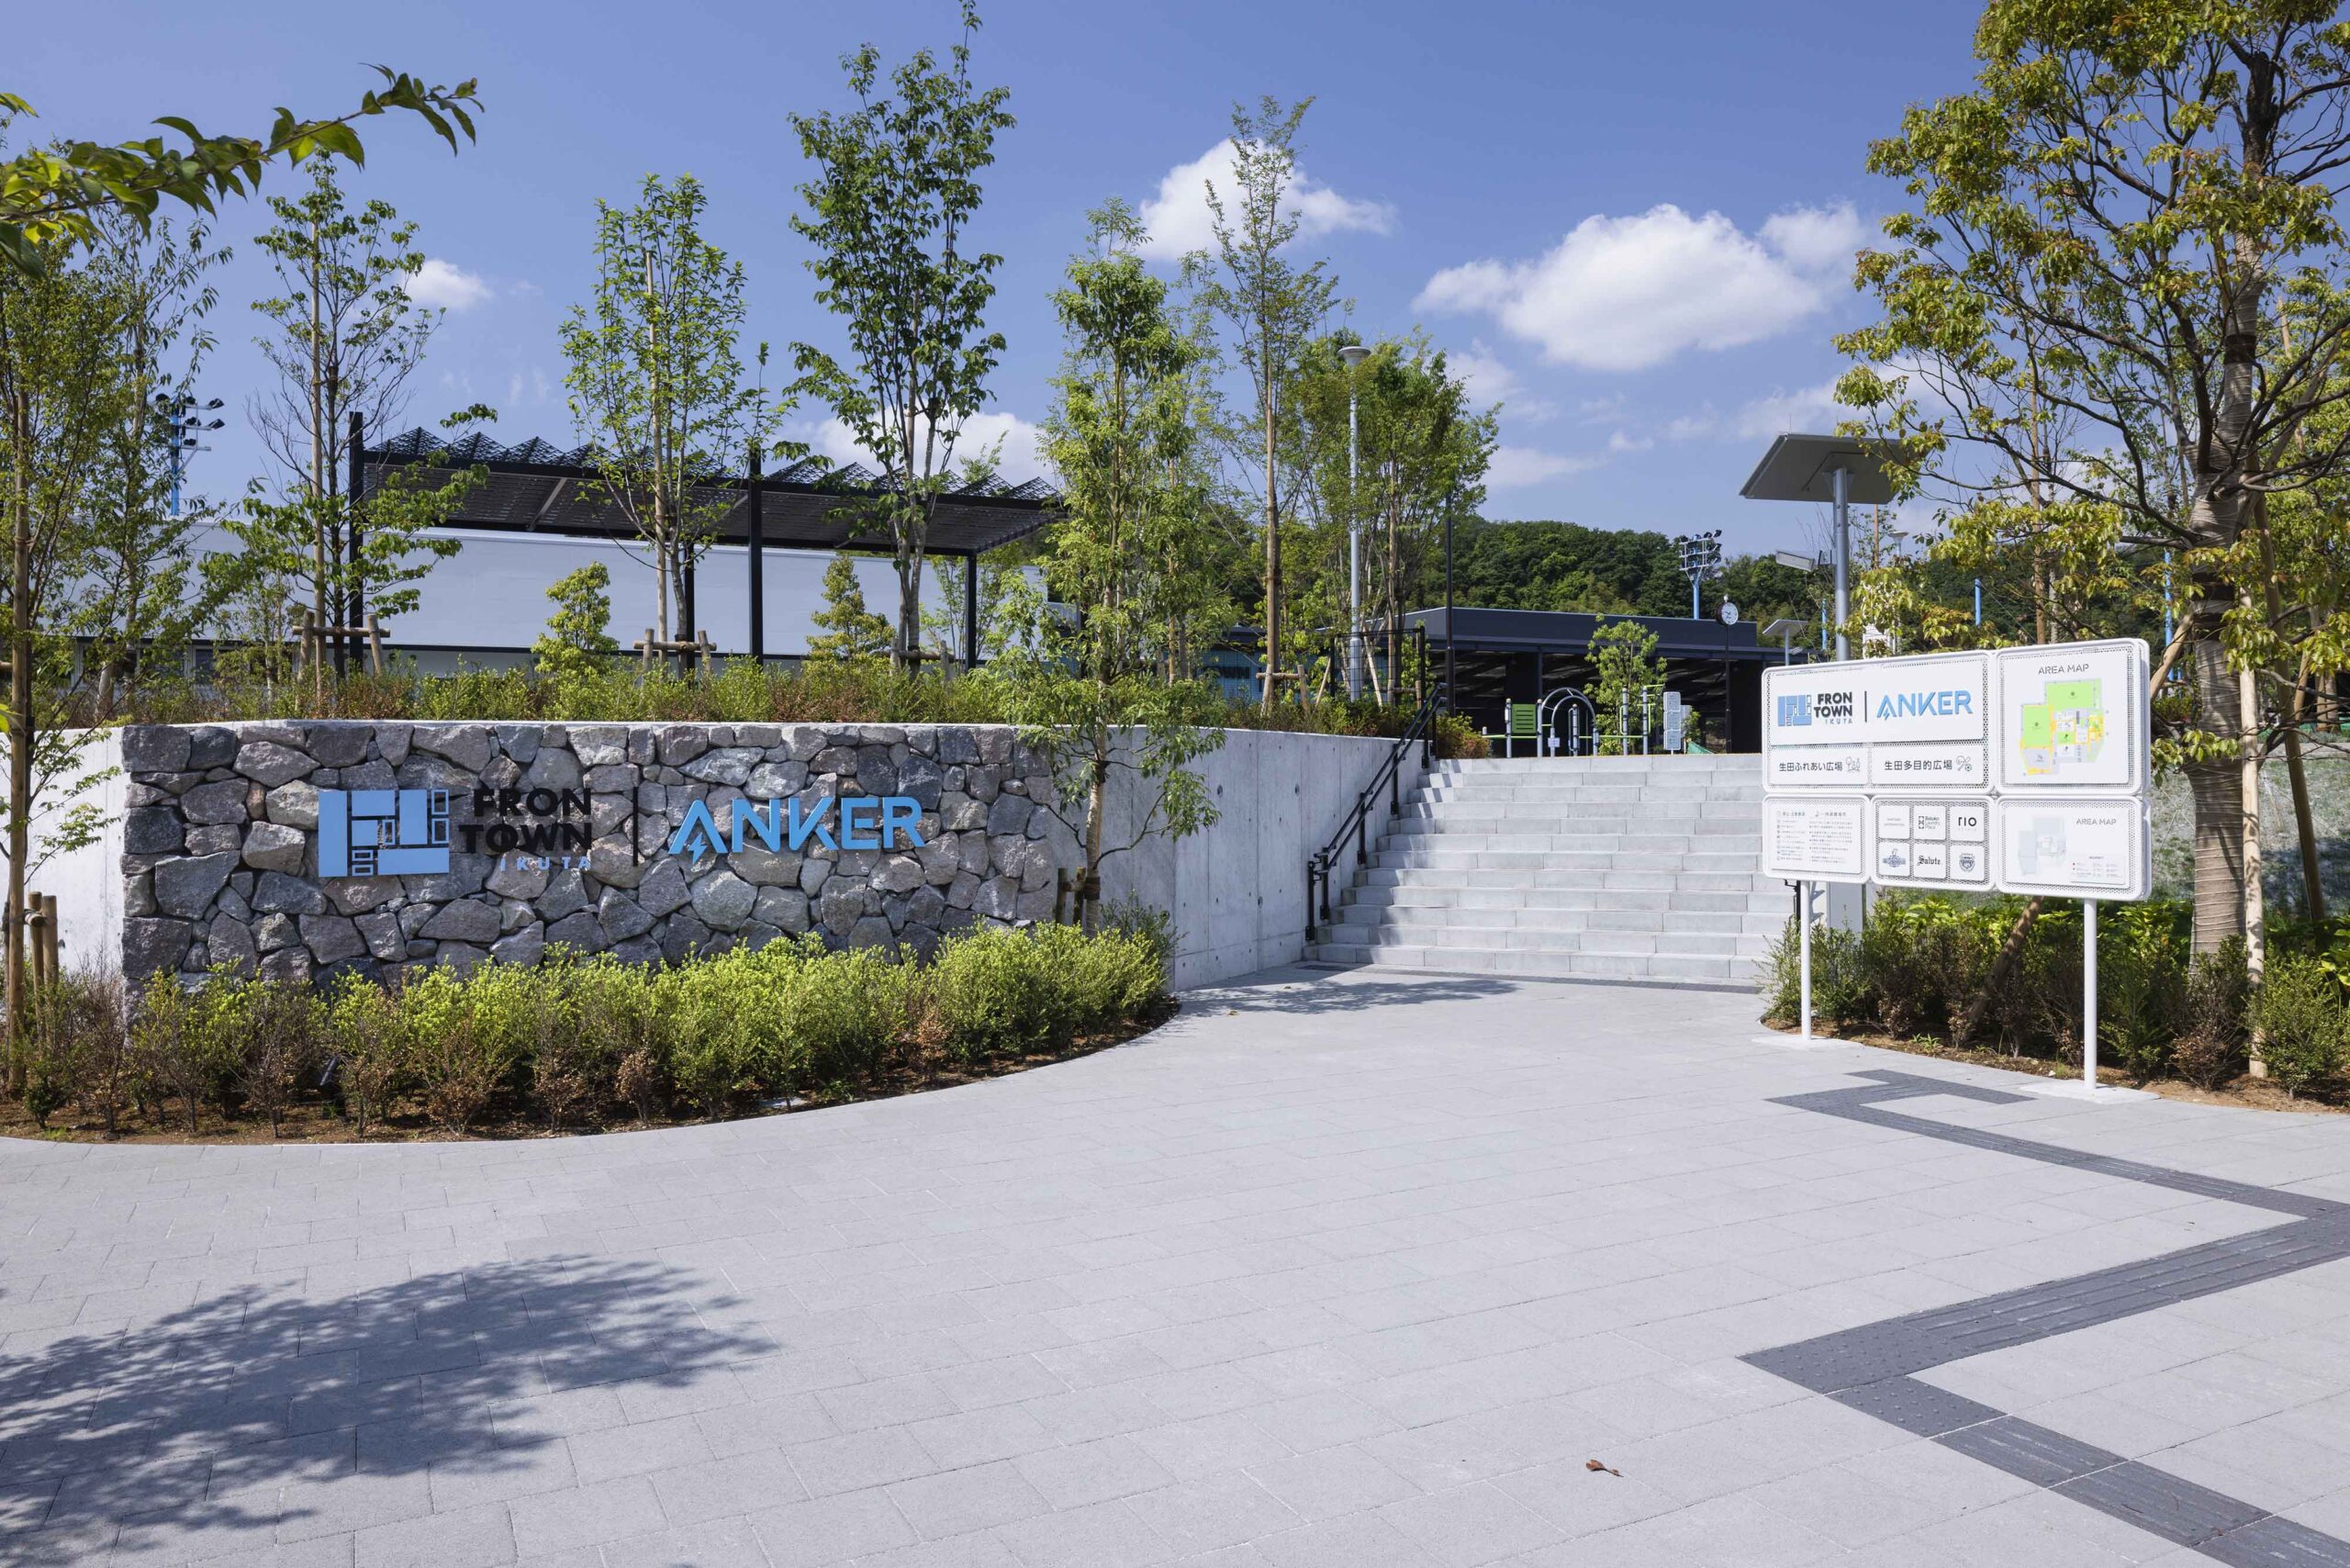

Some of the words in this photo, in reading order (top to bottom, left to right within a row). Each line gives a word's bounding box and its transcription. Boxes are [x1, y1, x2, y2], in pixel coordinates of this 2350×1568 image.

[2038, 665, 2065, 675] AREA
[2067, 663, 2089, 673] MAP
[1817, 691, 1852, 705] FRON
[1876, 689, 1974, 720] ANKER
[1813, 705, 1852, 718] TOWN
[1778, 761, 1843, 772] 生田ふれあい広場
[1884, 759, 1953, 771] 生田多目的広場
[474, 788, 591, 816] FRON
[668, 796, 926, 864] ANKER
[460, 823, 592, 854] TOWN
[499, 856, 592, 871] IKUTA
